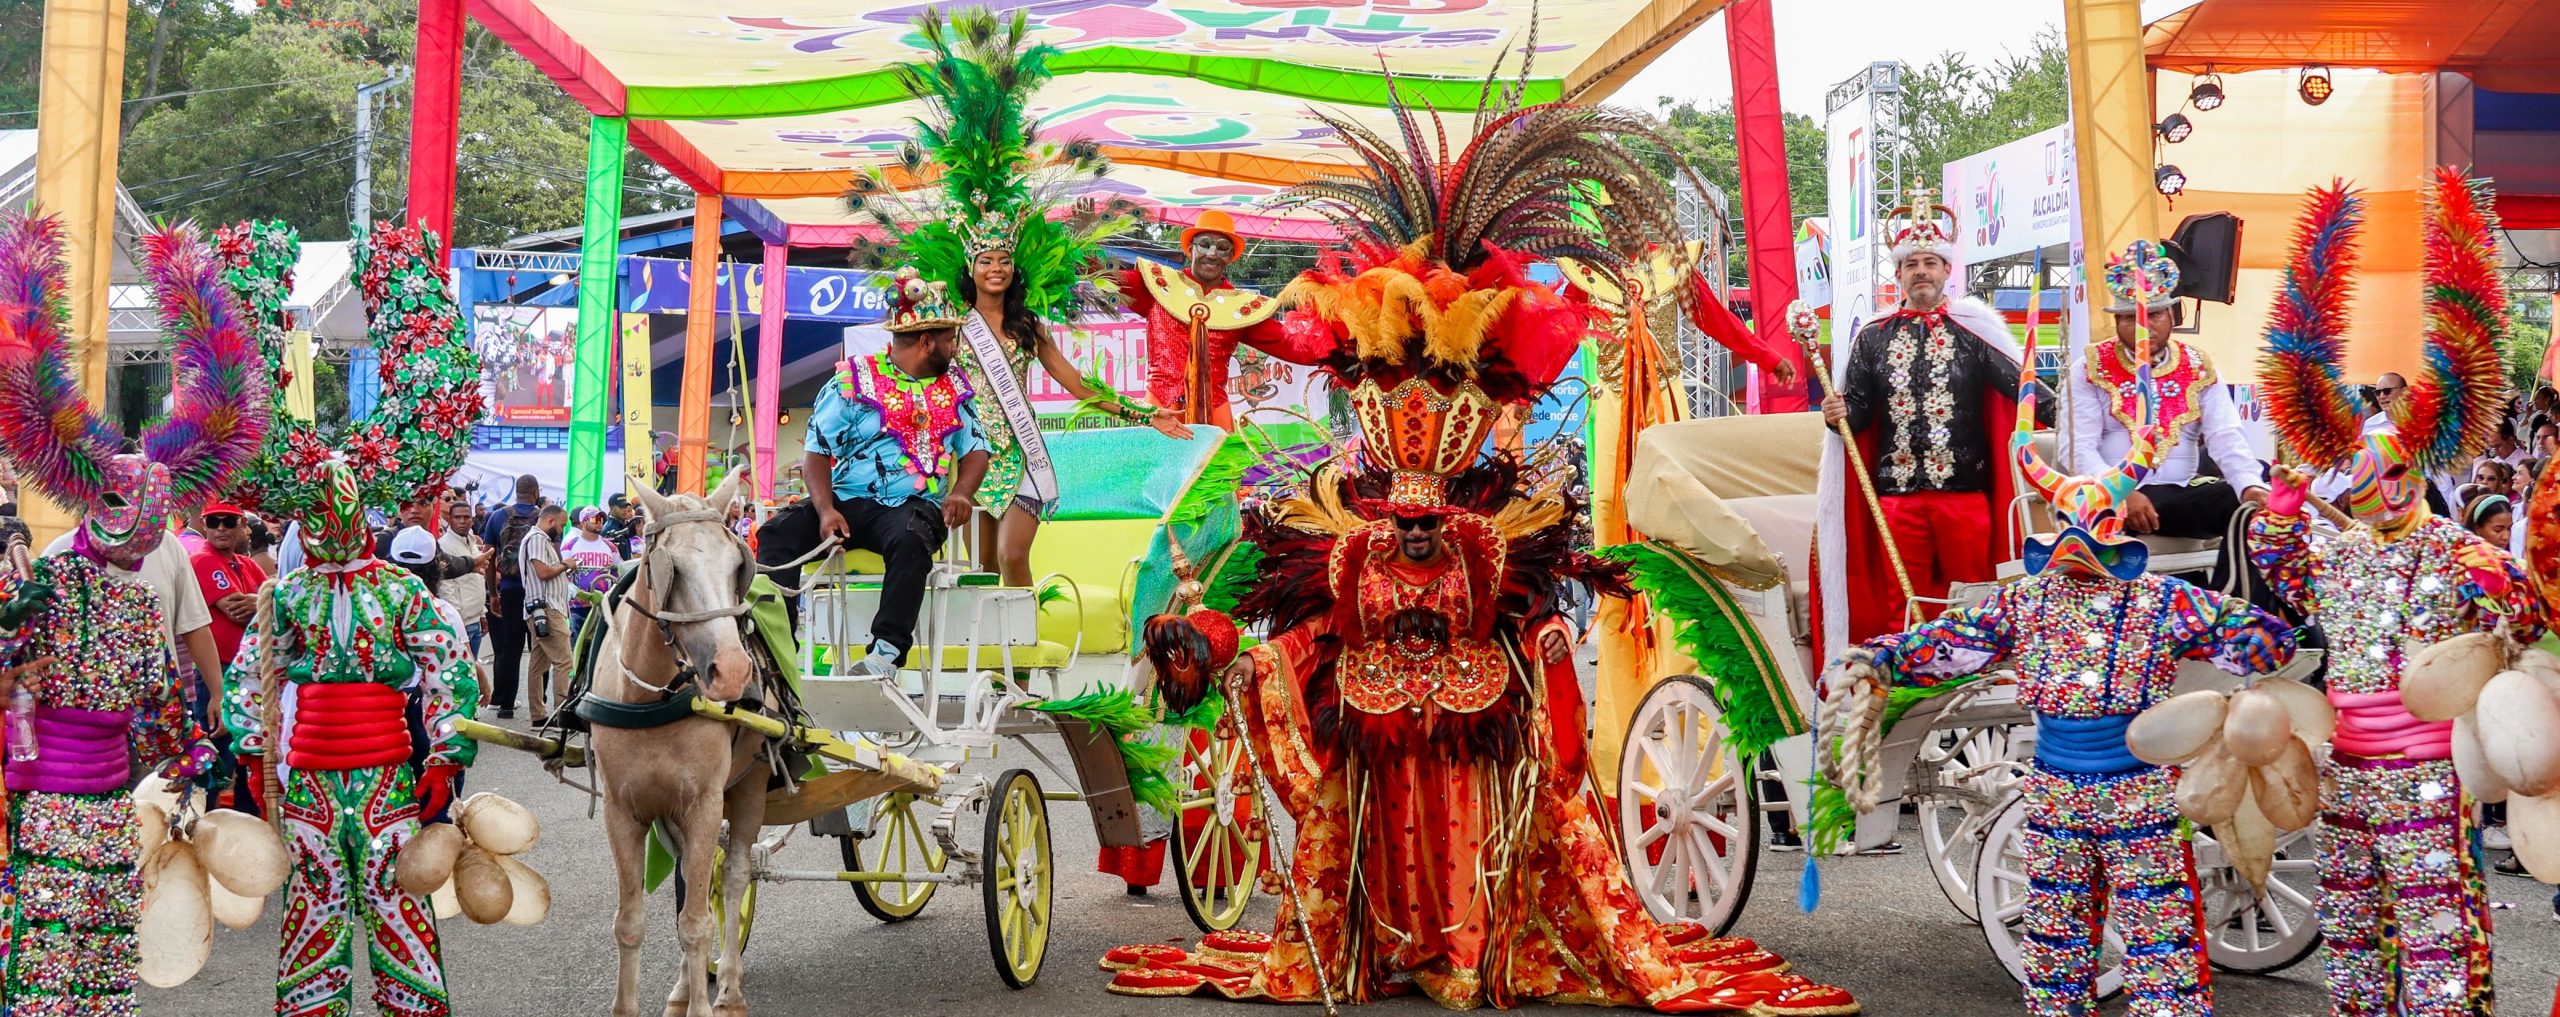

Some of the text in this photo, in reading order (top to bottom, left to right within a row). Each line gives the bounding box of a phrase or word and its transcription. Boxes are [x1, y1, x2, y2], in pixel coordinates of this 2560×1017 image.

[2033, 186, 2069, 217] ALCALDÍA
[977, 339, 996, 358] DEL
[987, 359, 1014, 397] CARNAVAL
[1006, 397, 1021, 411] DE
[1013, 410, 1040, 456] SANTIAGO
[1029, 457, 1049, 472] 2025
[212, 570, 230, 590] 3
